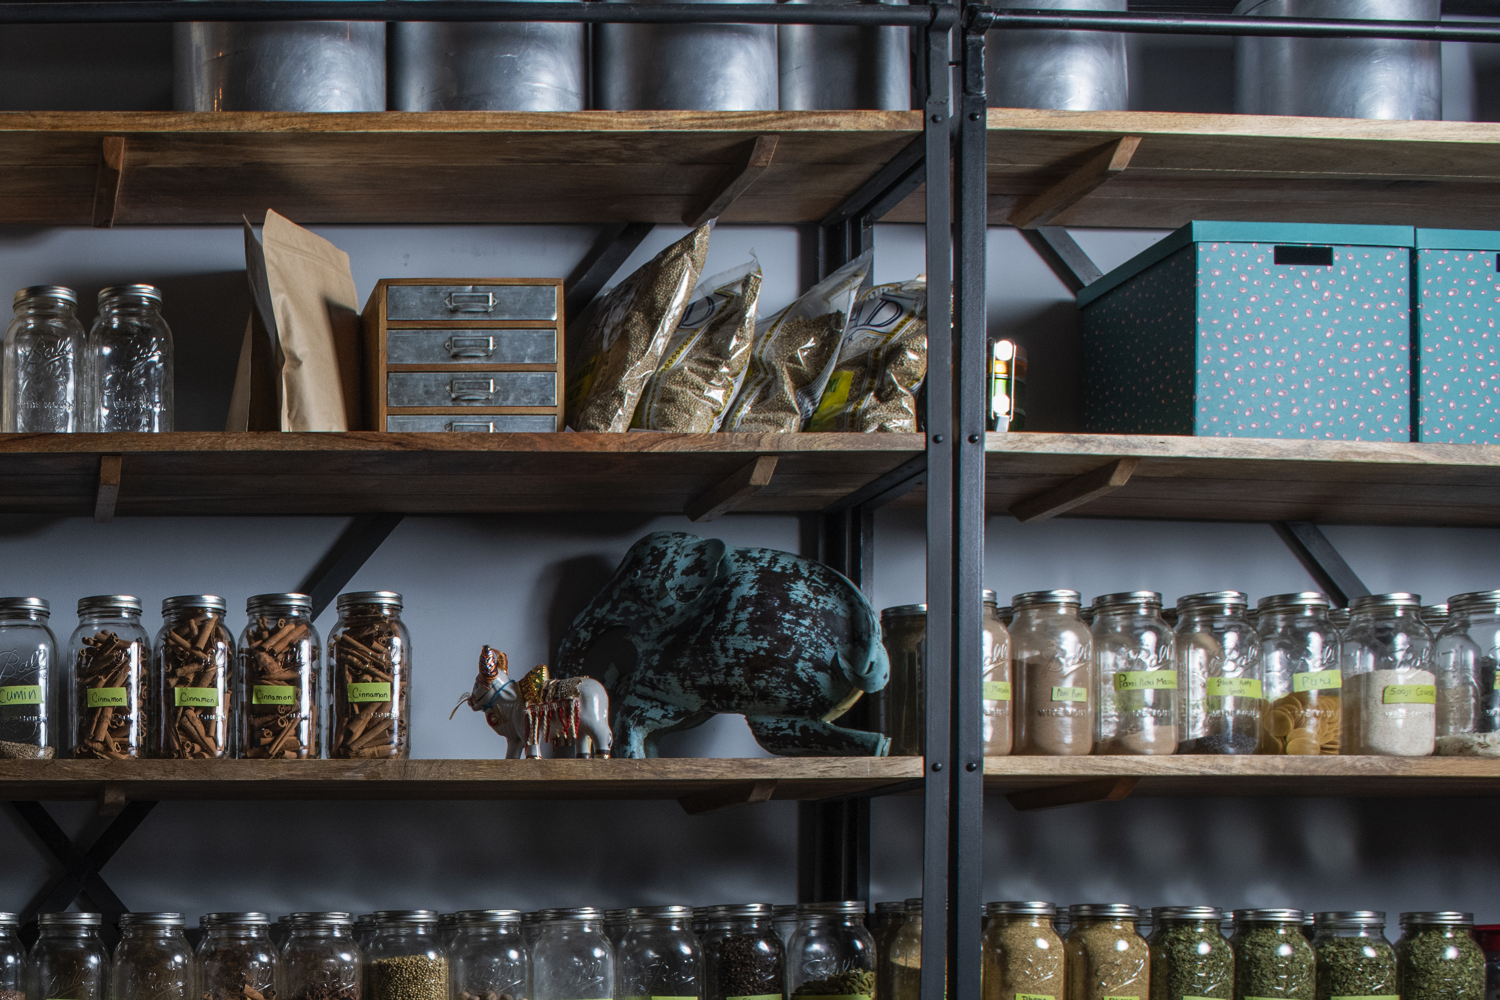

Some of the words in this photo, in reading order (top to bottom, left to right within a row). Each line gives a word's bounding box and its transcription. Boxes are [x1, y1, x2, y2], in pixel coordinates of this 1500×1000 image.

[1119, 674, 1137, 688] Pani
[181, 692, 214, 703] Cinnamon
[256, 690, 292, 700] Cinnamon
[353, 688, 388, 698] Cinnamon
[92, 694, 122, 703] Cinnamon
